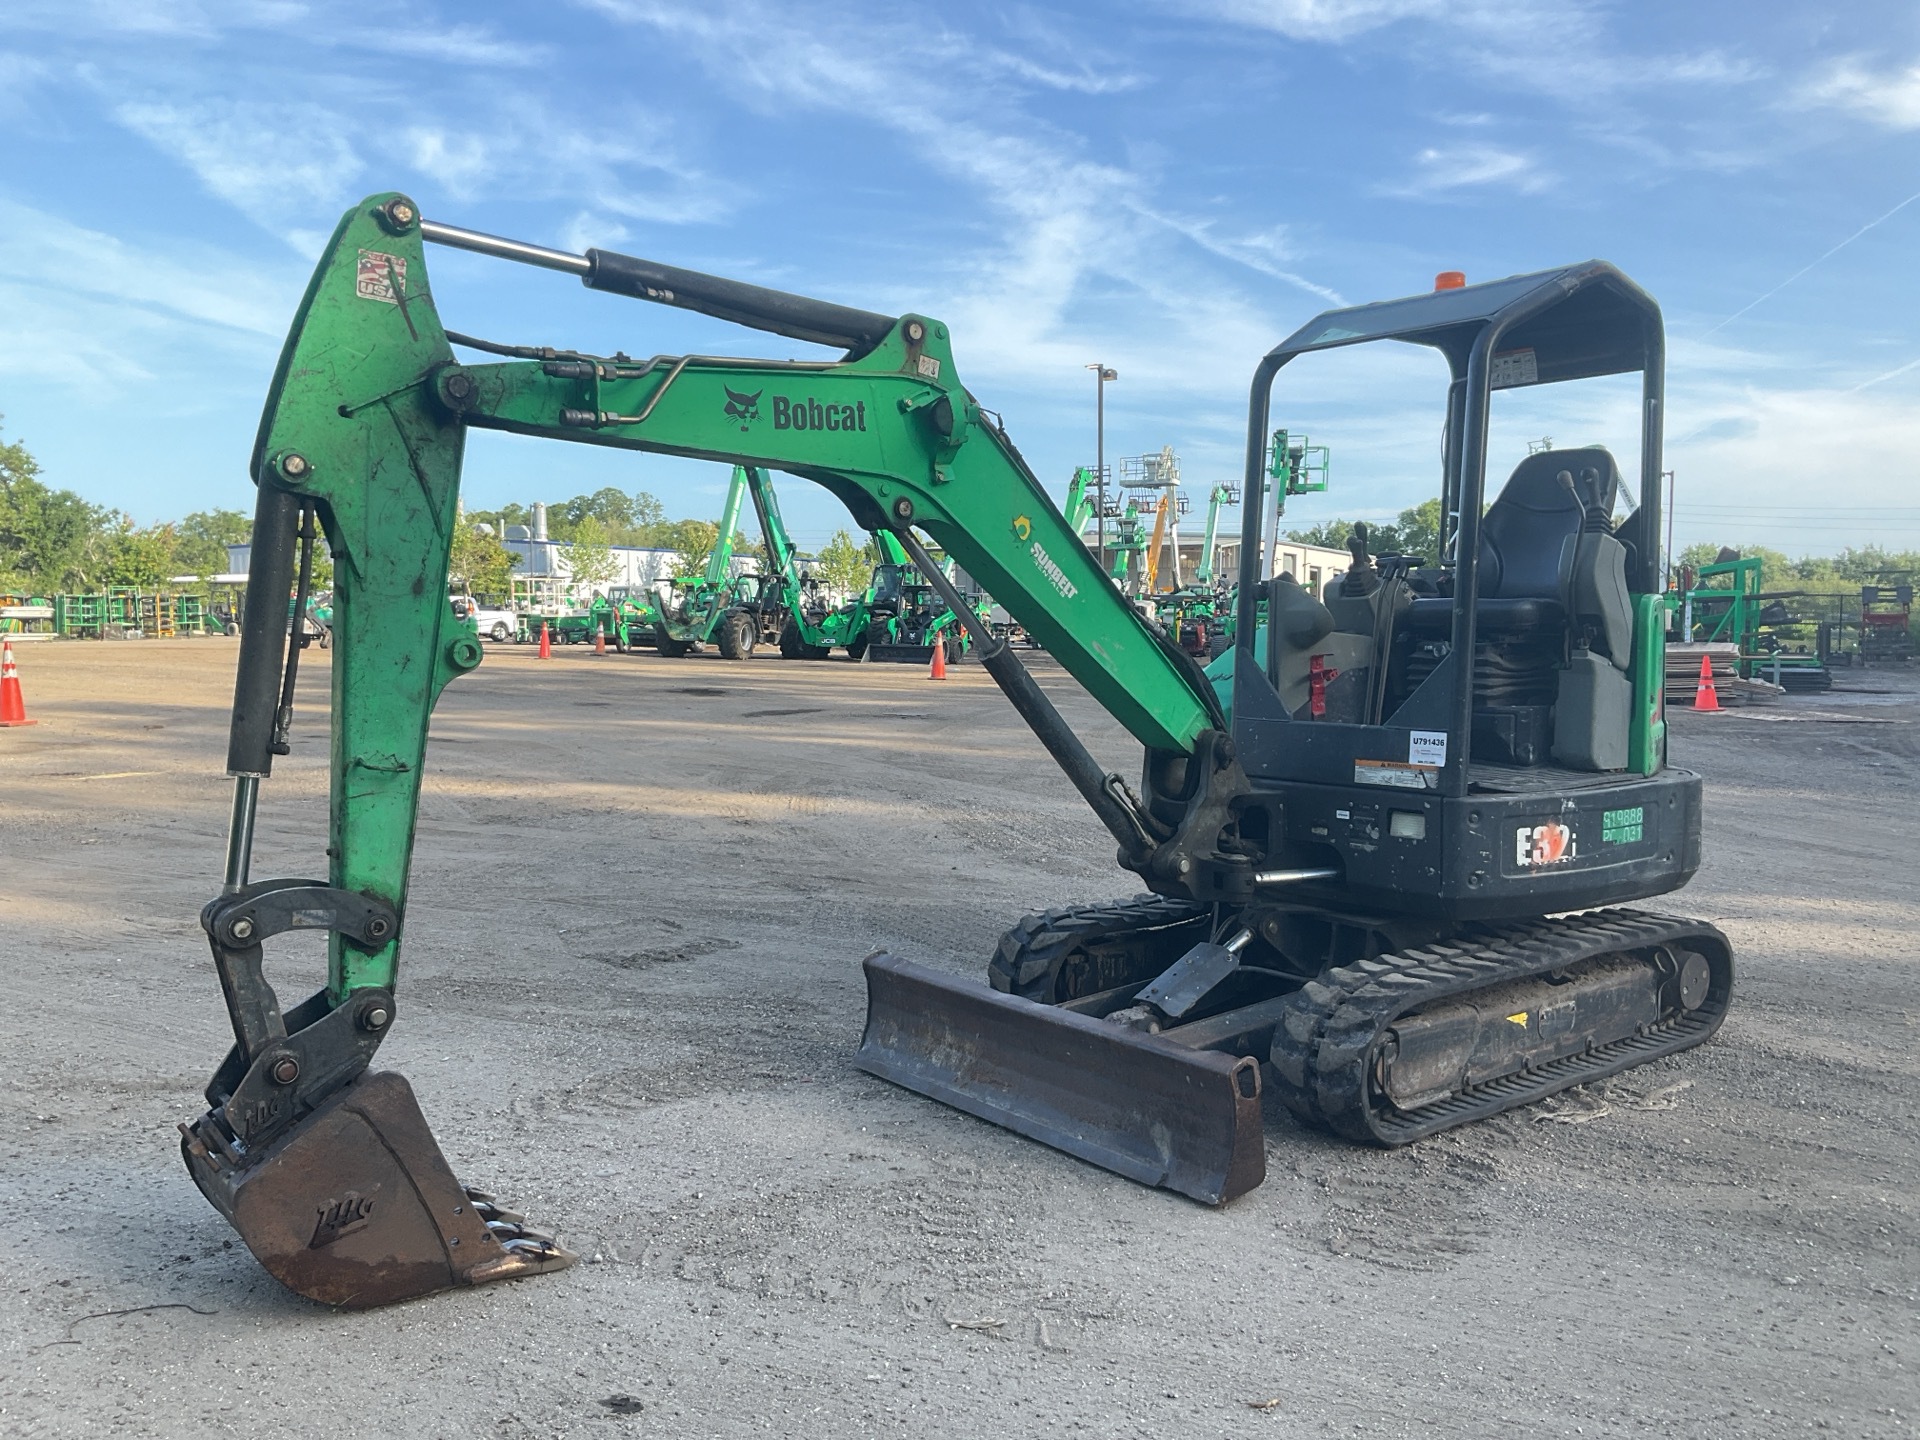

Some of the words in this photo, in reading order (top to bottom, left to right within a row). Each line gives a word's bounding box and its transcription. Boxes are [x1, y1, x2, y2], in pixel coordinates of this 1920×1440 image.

[772, 396, 866, 432] Bobcat
[1030, 542, 1078, 599] SUNBELT
[1033, 560, 1066, 598] RENTALS
[1413, 737, 1445, 746] U791436
